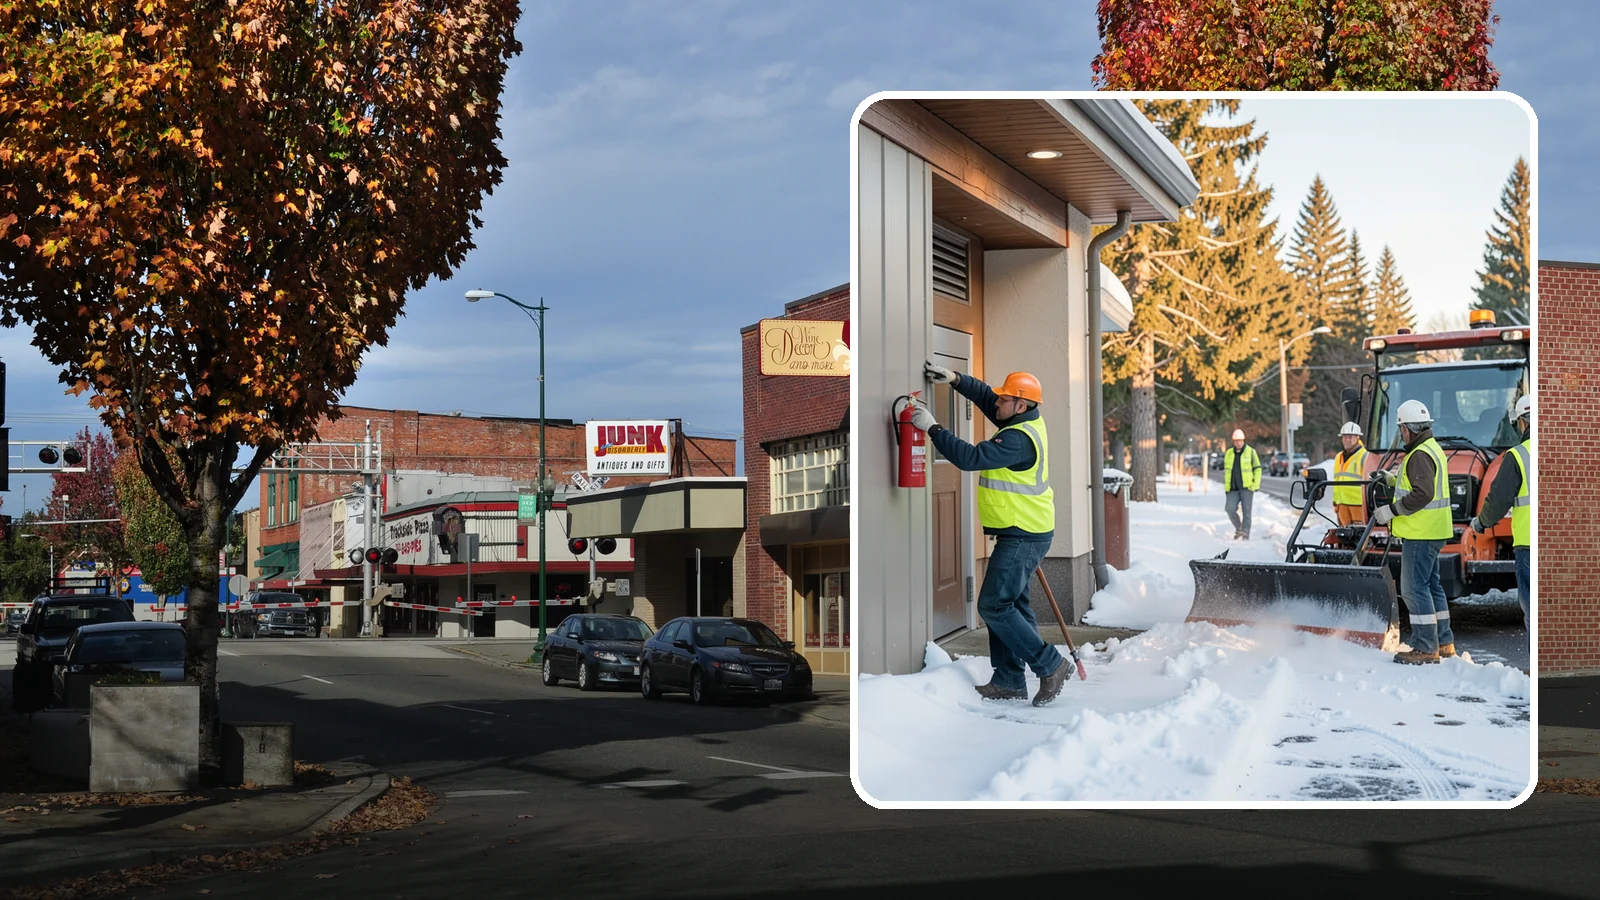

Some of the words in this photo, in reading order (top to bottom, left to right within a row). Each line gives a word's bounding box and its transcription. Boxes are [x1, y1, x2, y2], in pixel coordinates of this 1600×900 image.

[595, 425, 665, 457] JUNK
[607, 446, 646, 454] DISORDERLY
[596, 461, 628, 470] ANTIQUES
[631, 461, 644, 470] AND
[647, 460, 665, 469] GIFTS
[390, 521, 413, 539] Trackside
[414, 520, 429, 535] Pizza
